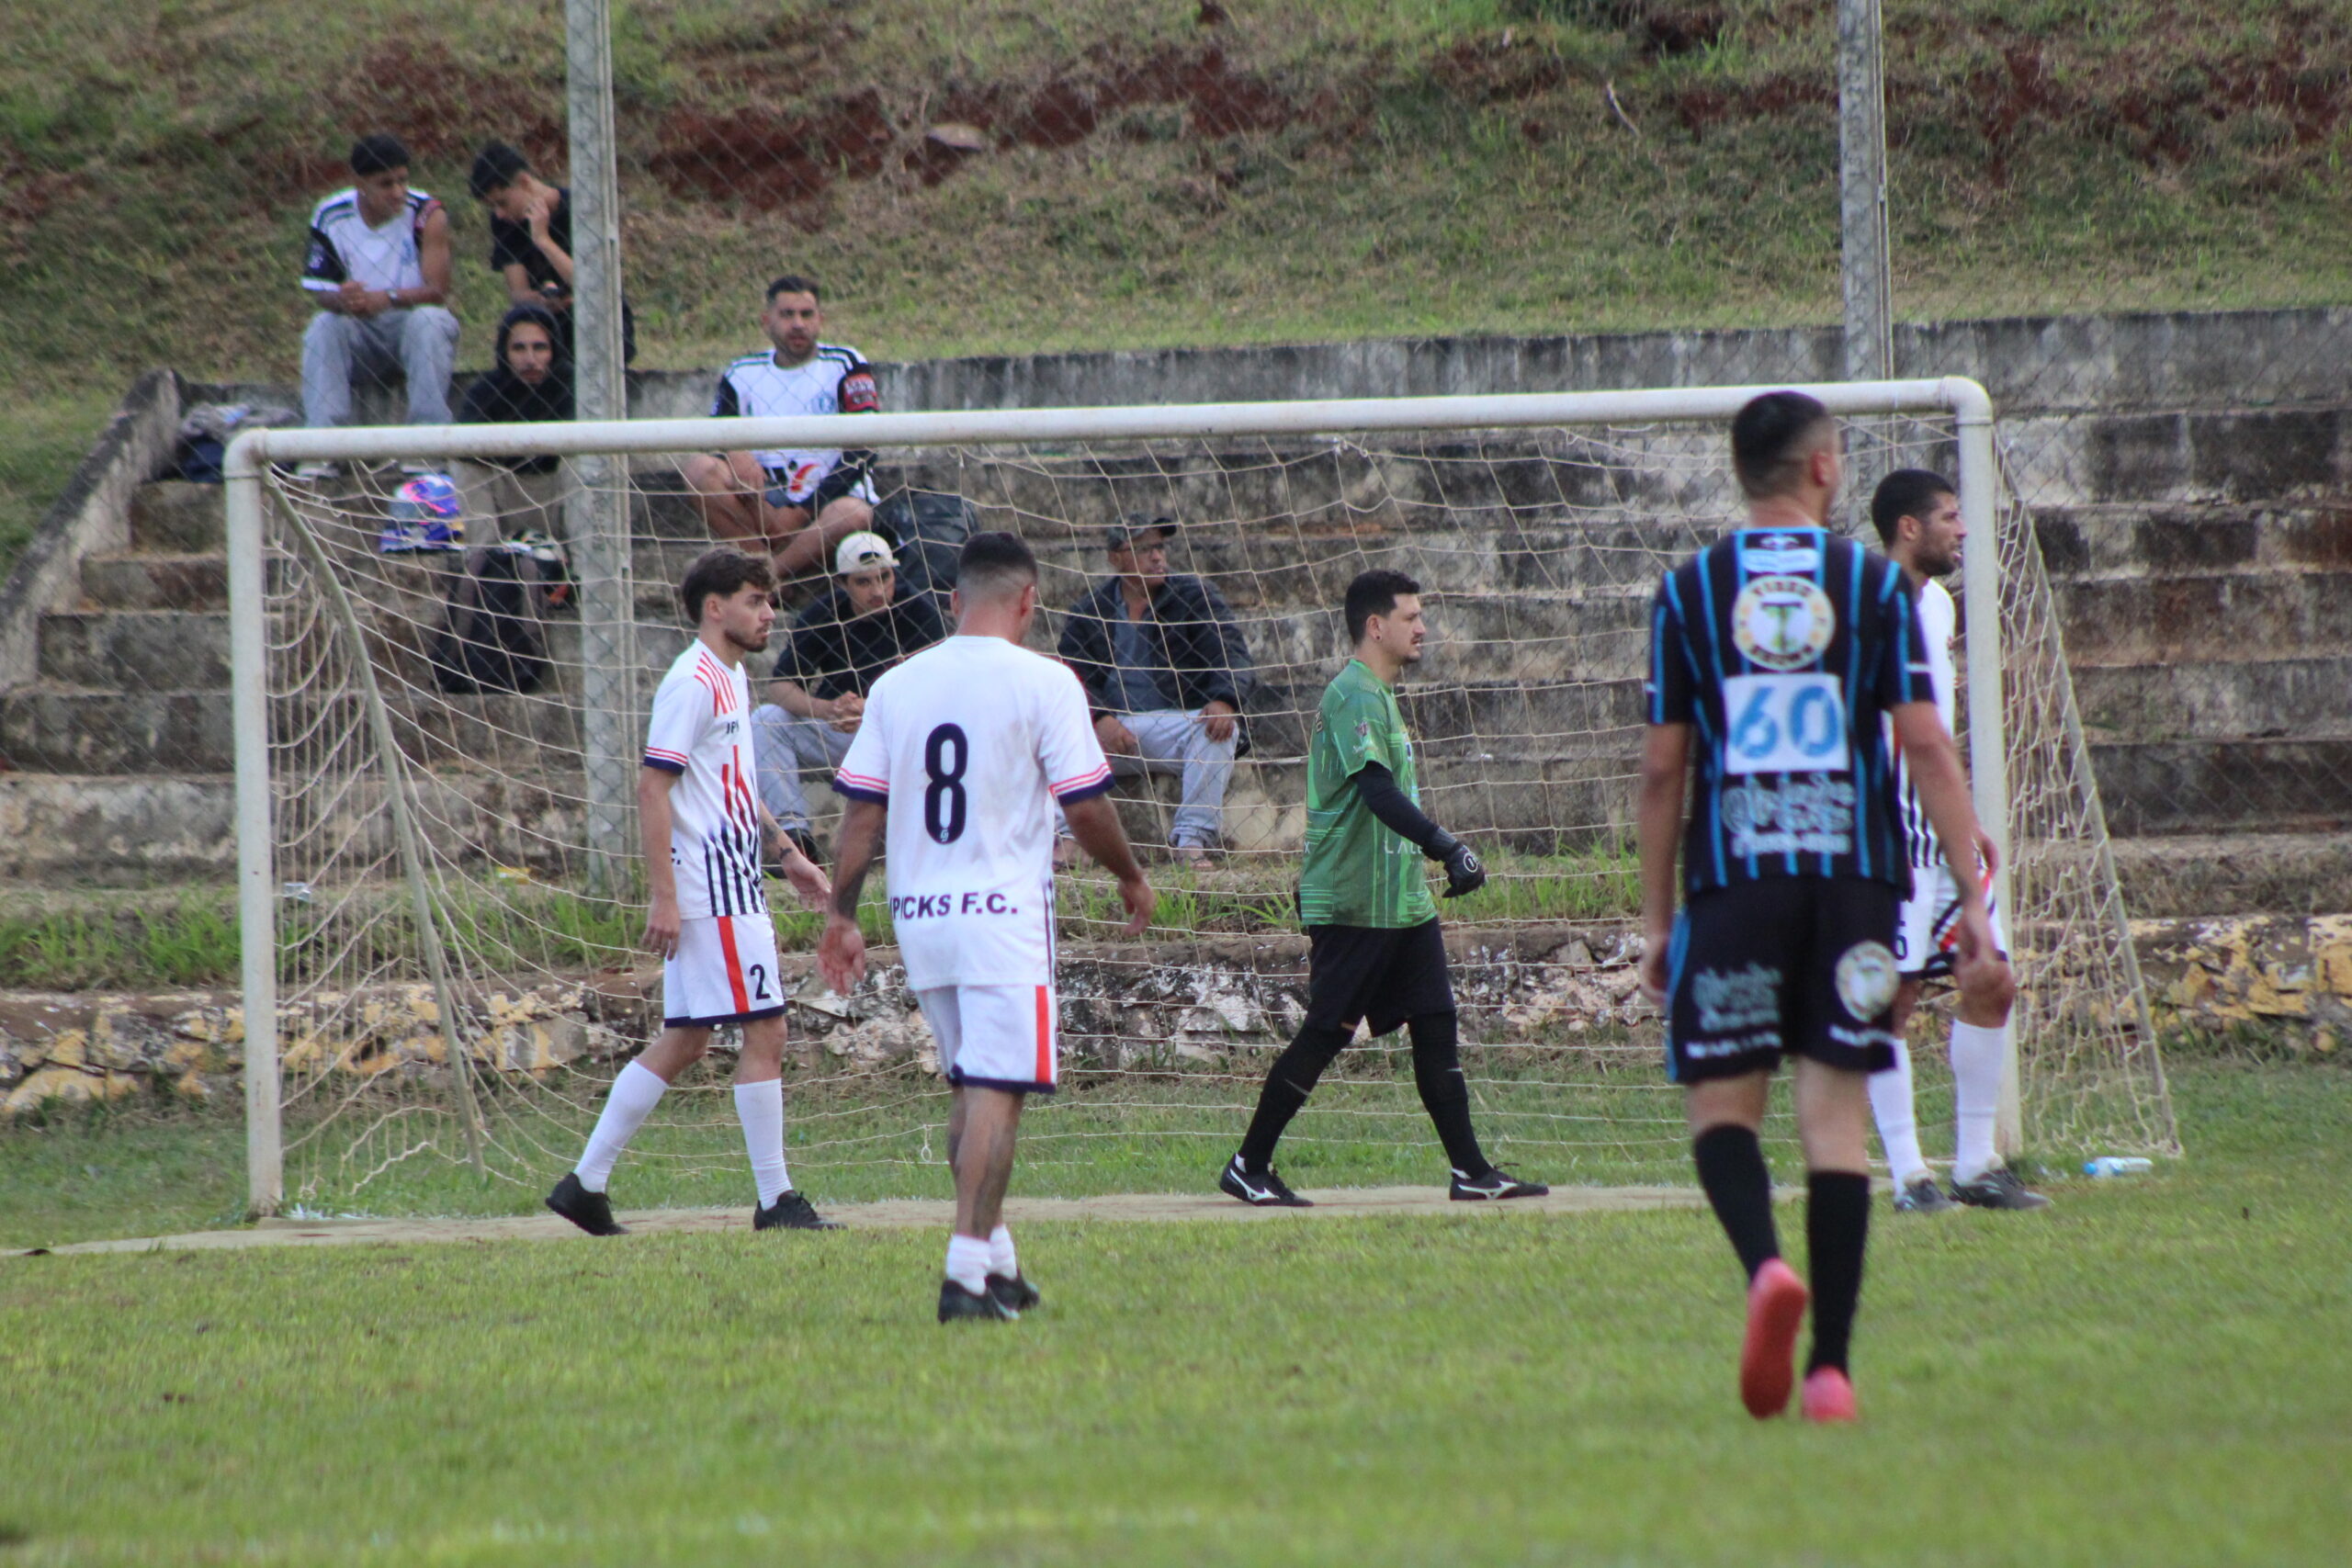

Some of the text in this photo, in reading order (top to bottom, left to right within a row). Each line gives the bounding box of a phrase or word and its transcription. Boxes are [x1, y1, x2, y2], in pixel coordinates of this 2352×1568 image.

[1730, 685, 1838, 758] 60
[924, 722, 968, 844] 8
[961, 892, 1018, 914] F.C.
[750, 964, 772, 1000] 2
